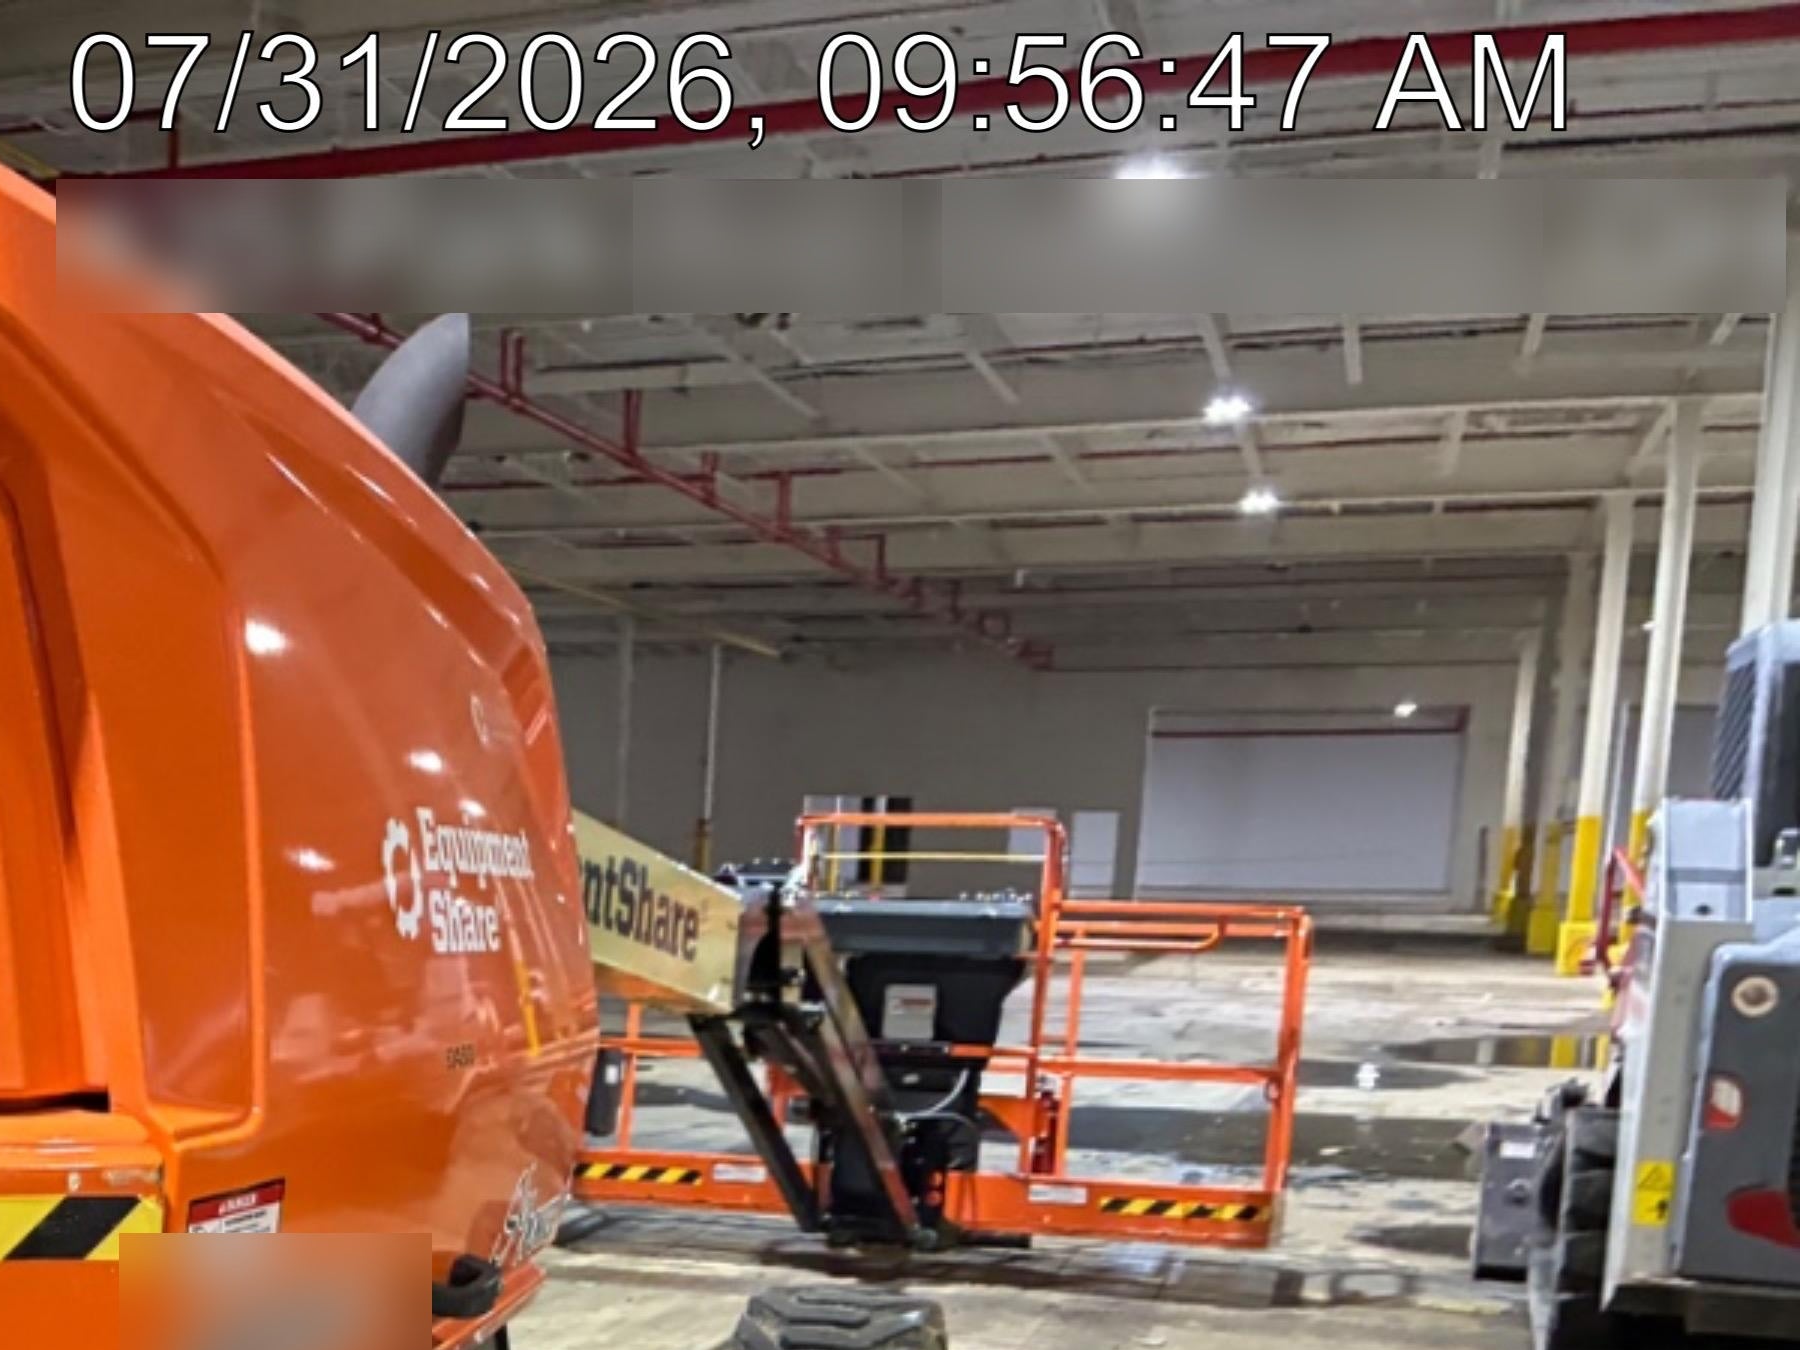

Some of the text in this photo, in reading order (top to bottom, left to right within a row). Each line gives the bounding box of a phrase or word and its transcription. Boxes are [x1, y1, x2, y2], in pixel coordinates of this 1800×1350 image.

[416, 806, 535, 890] Equipment
[428, 888, 501, 954] Share
[578, 855, 699, 962] ntShare
